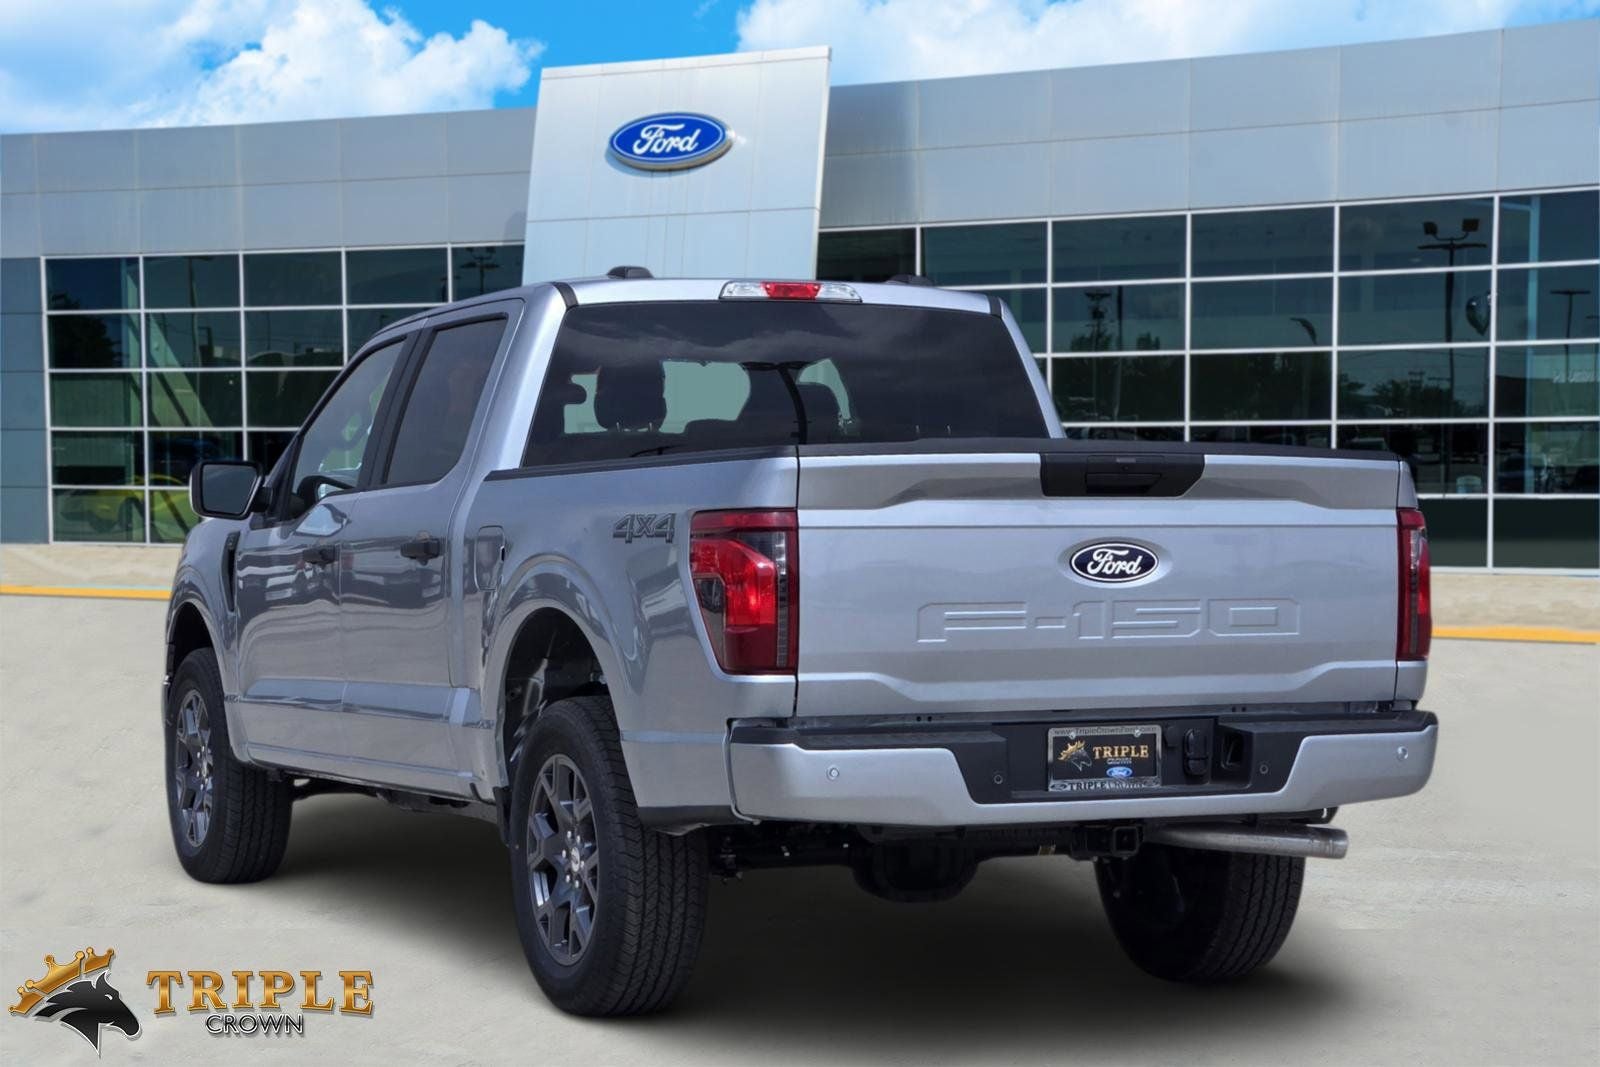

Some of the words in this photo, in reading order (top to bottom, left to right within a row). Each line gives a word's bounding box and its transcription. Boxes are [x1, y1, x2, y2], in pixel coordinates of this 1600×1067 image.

[632, 123, 701, 155] Ford
[1086, 548, 1143, 575] Ford
[916, 599, 1300, 643] F-150
[1054, 726, 1157, 736] wwwTripleCrownFordcom
[1092, 745, 1149, 760] TRIPLE
